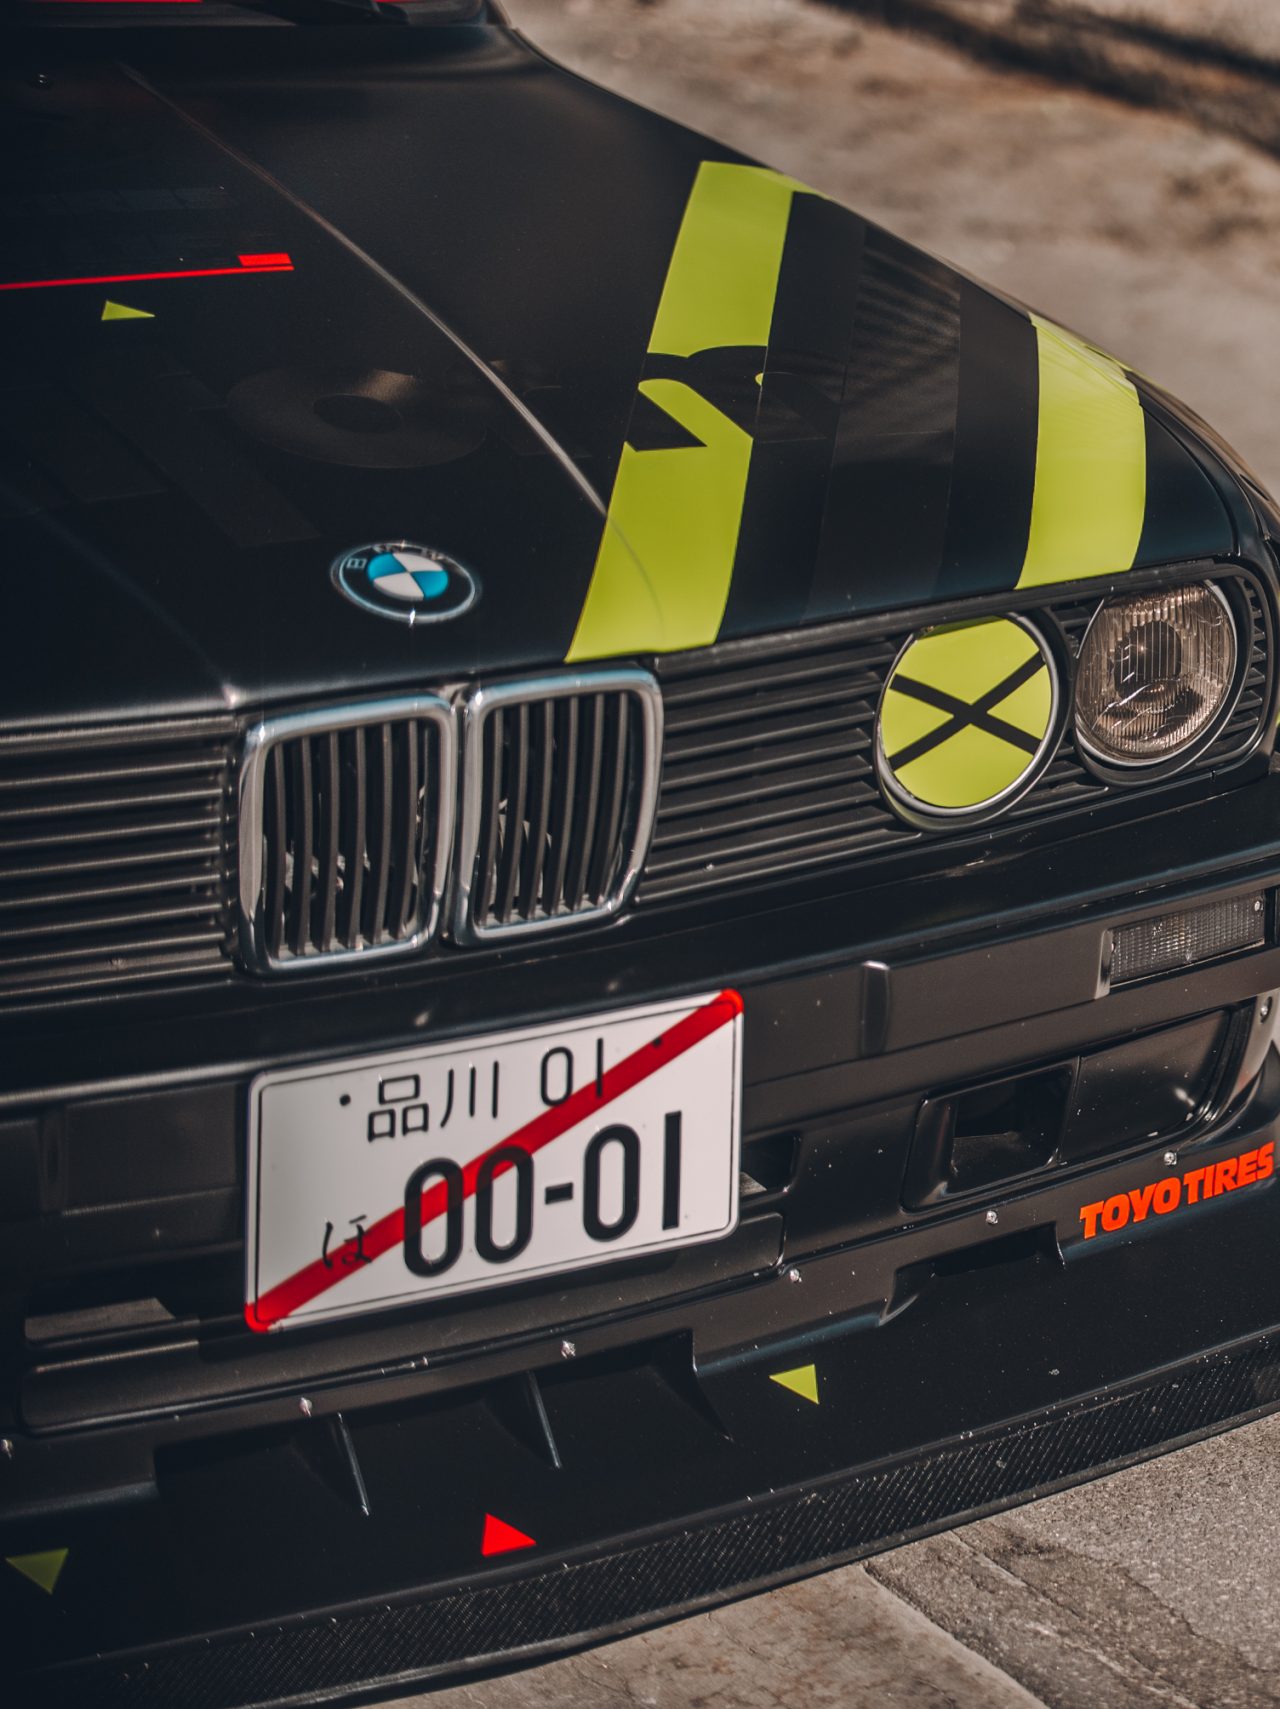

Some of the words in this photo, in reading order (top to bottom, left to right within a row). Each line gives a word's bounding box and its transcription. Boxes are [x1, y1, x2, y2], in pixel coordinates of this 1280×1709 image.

[367, 1061, 499, 1143] 品川
[540, 1037, 605, 1109] 01
[403, 1110, 683, 1278] 00-01
